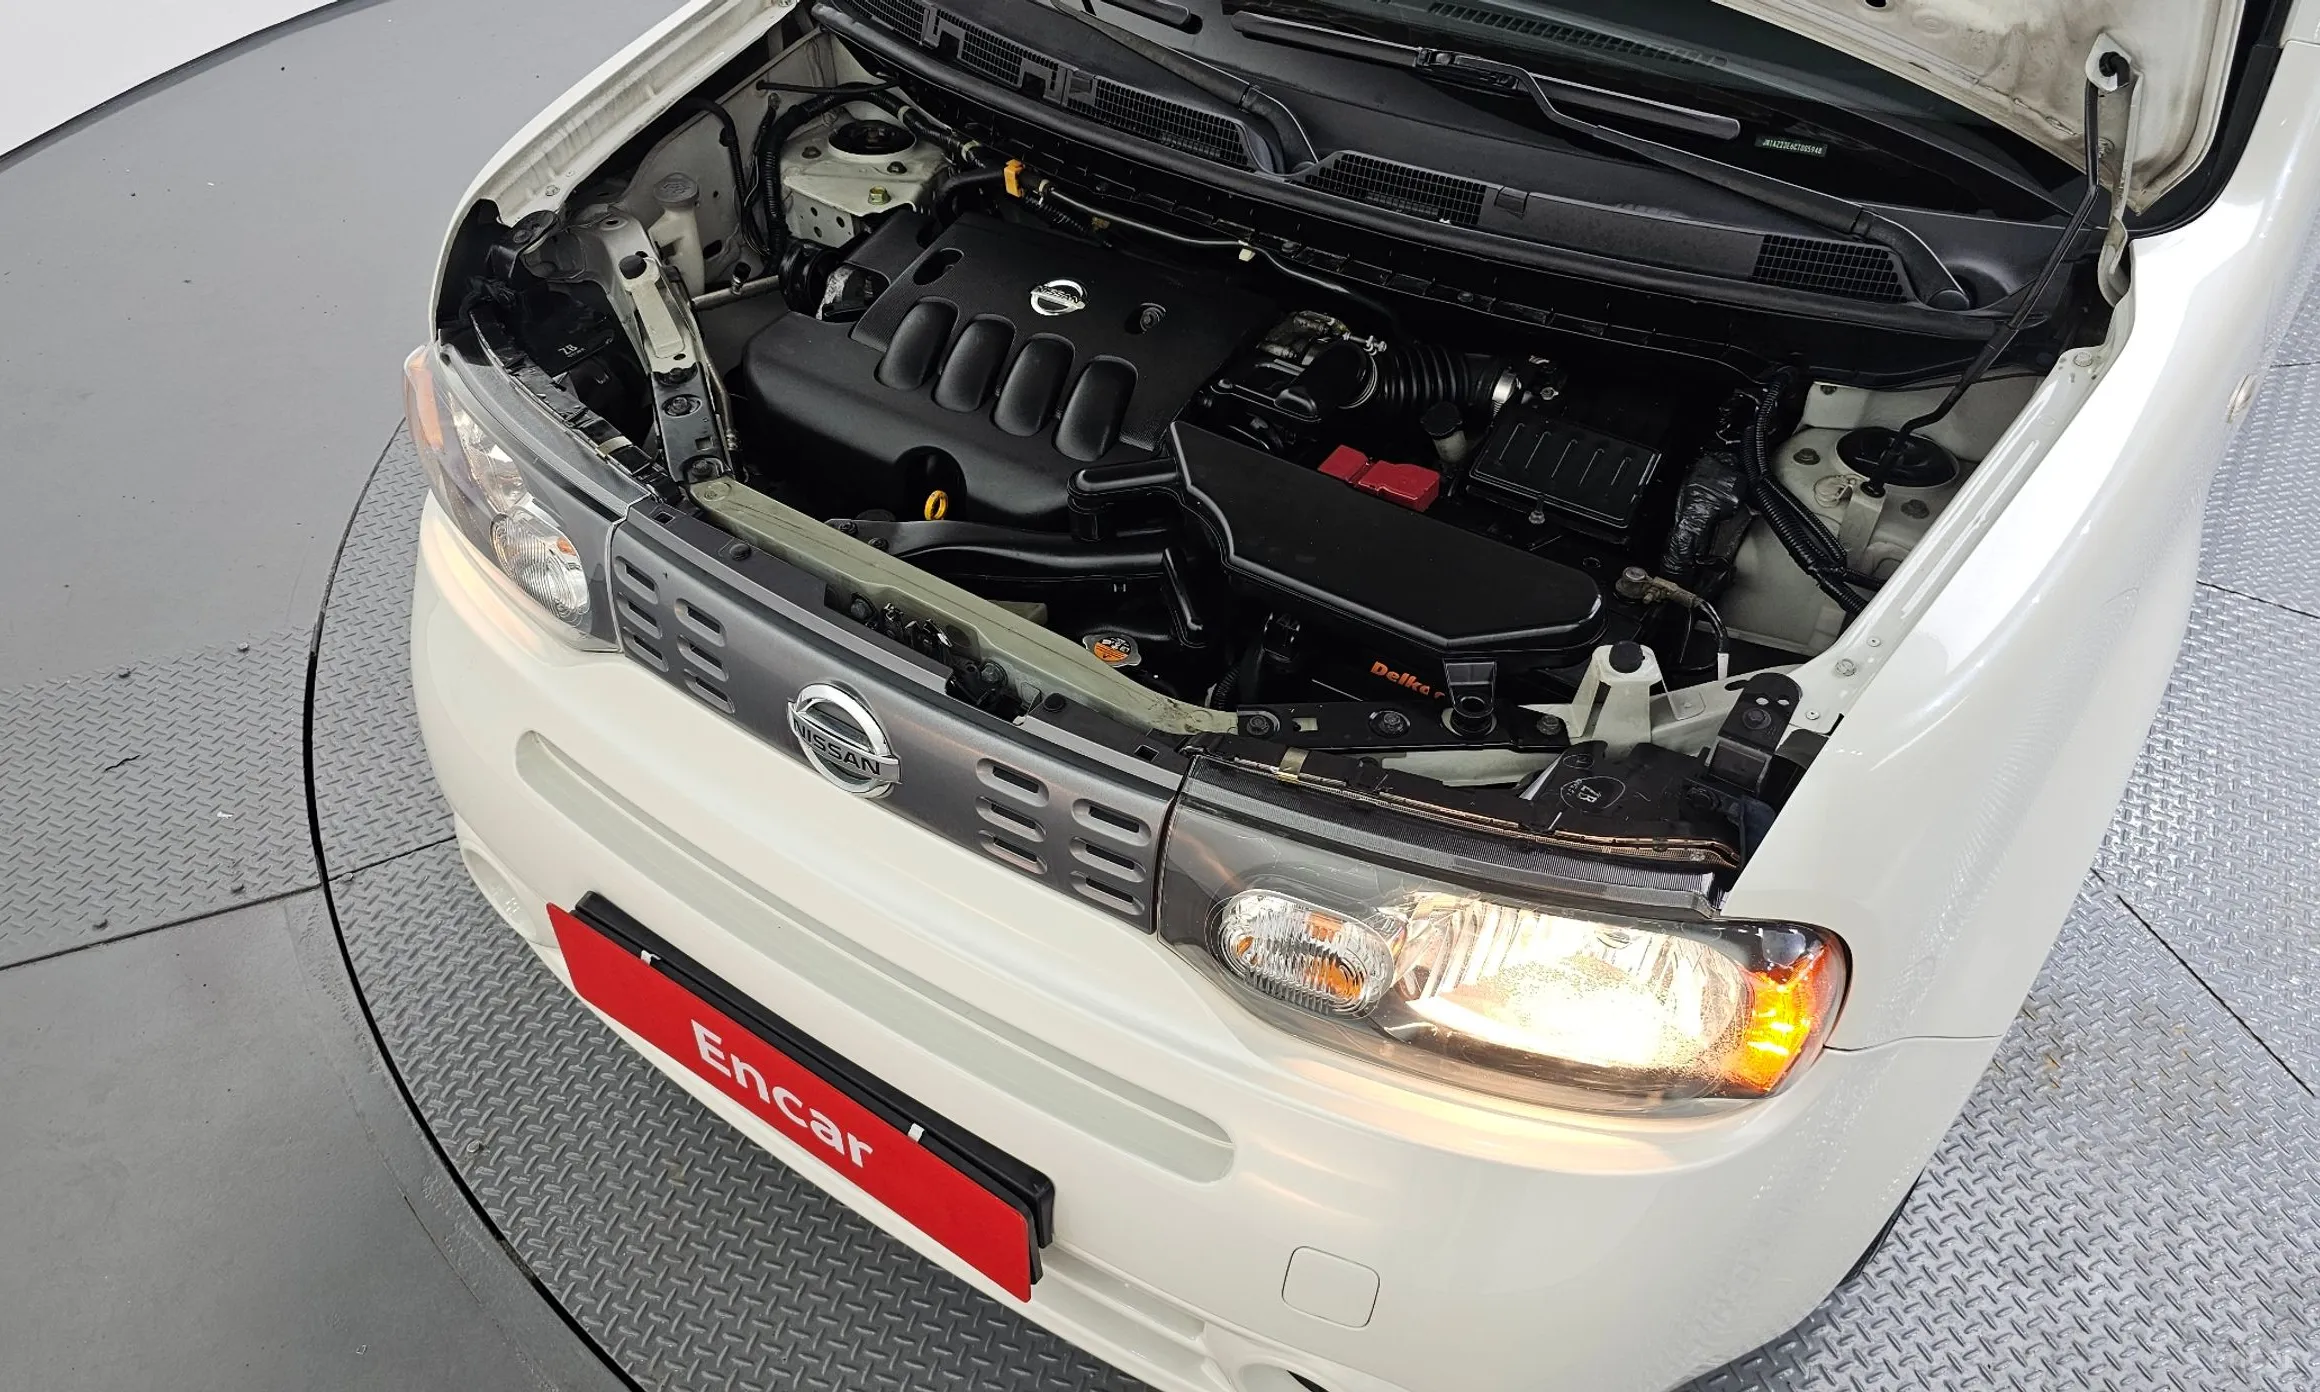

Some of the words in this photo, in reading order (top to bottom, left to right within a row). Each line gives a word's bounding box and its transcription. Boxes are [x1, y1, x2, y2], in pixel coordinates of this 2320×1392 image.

[1034, 285, 1079, 304] NISSAN
[793, 718, 881, 776] NISSAN
[690, 1018, 874, 1168] Encar
